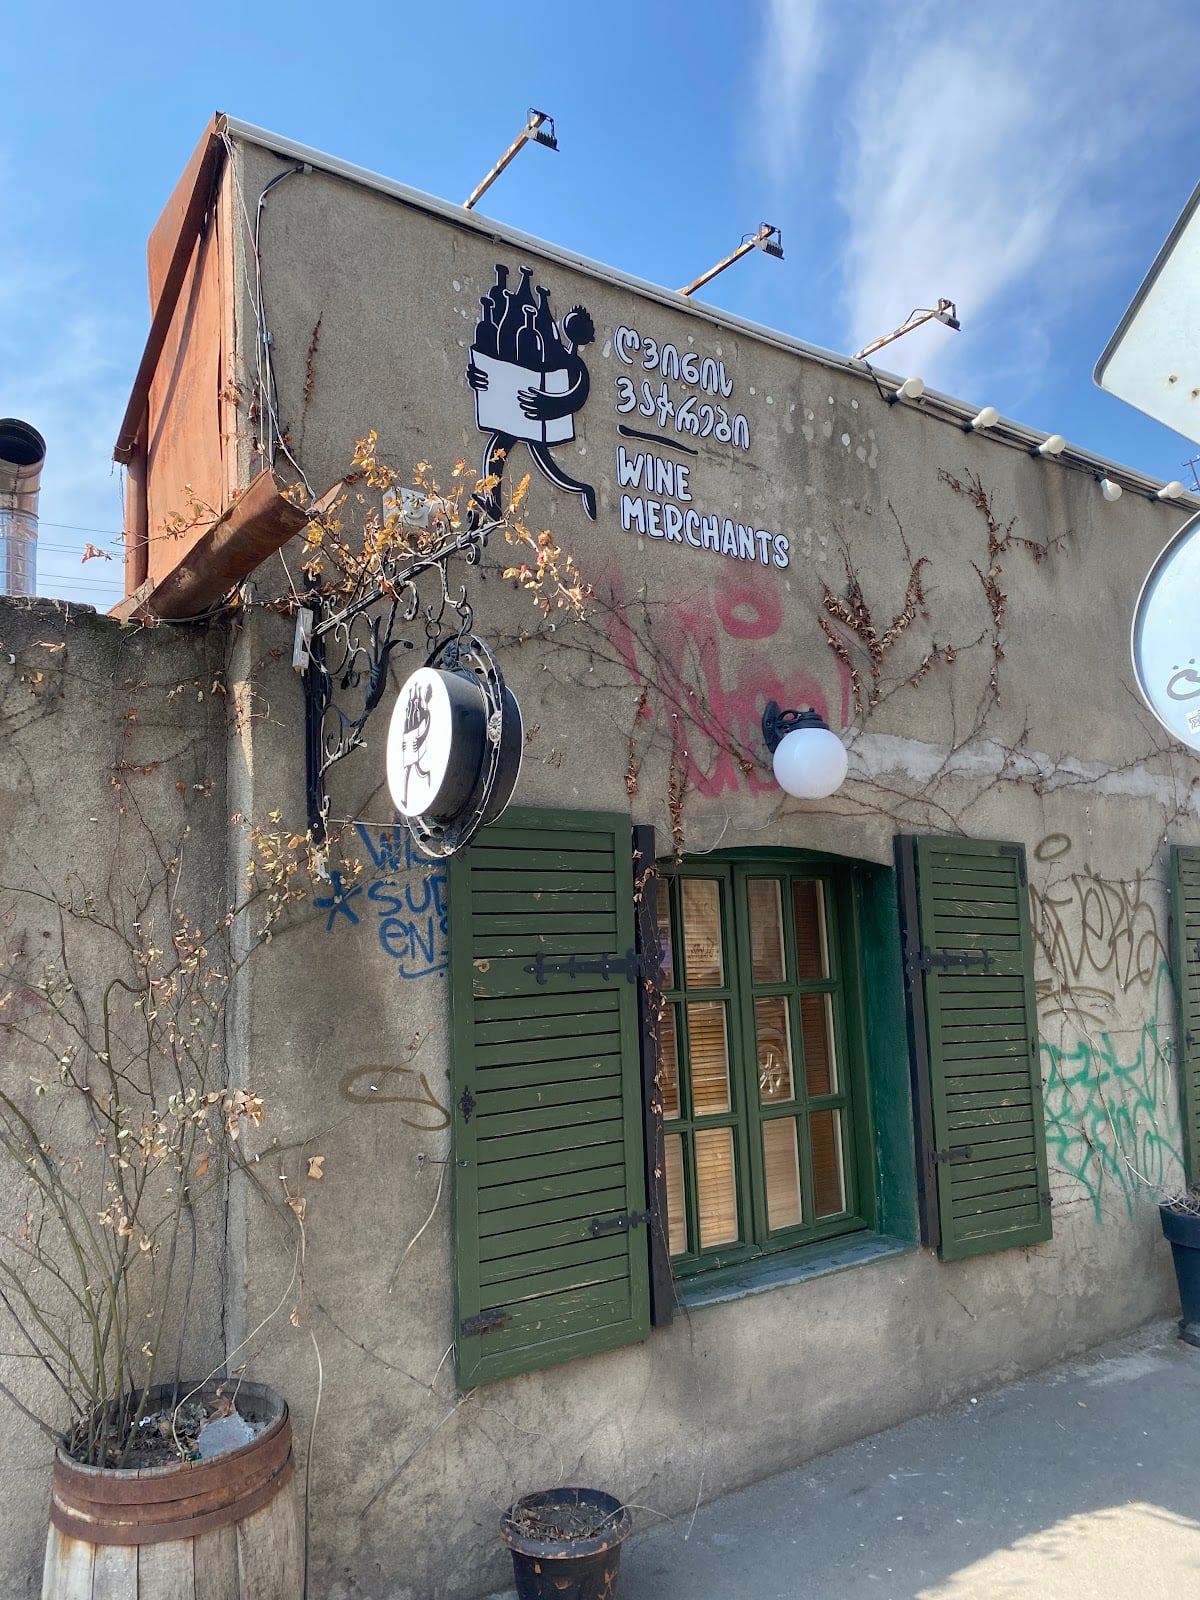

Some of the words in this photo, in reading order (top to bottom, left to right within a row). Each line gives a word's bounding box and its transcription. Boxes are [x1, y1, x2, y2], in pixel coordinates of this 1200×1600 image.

[615, 326, 733, 399] ღვინის
[615, 377, 750, 449] ვაჭრები
[617, 446, 692, 501] WINE
[621, 494, 789, 569] MERCHANTS
